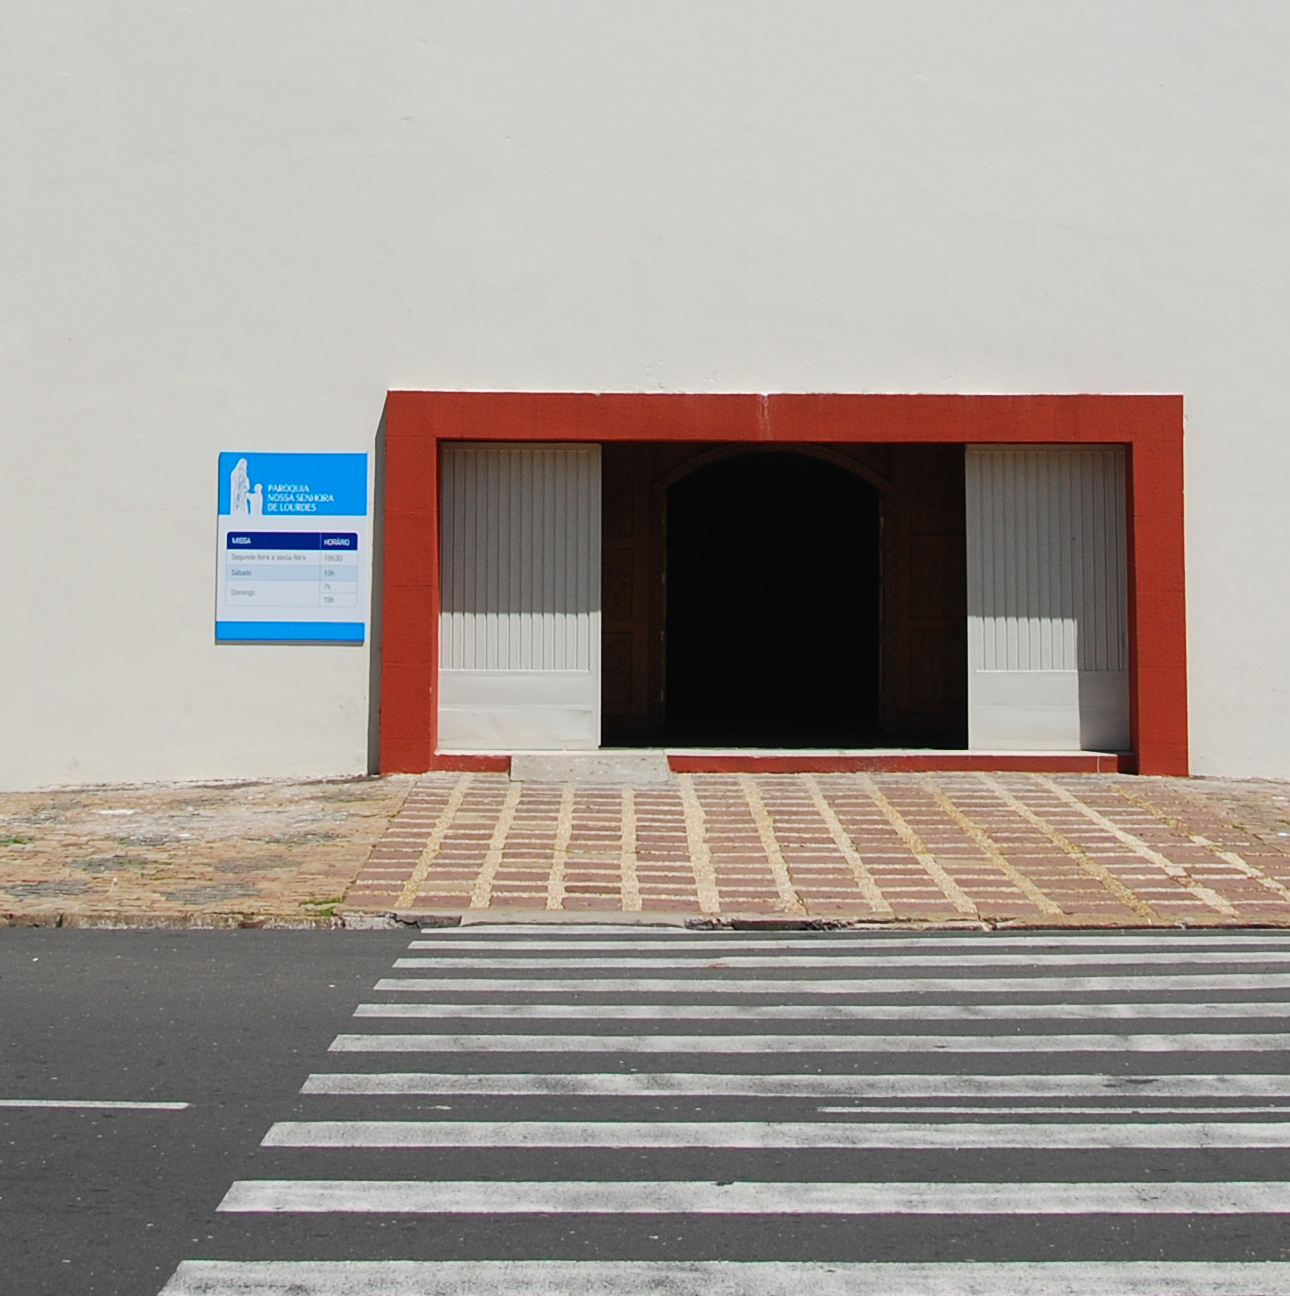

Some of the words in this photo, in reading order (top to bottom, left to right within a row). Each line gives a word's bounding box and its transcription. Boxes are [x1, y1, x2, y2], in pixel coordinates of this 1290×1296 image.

[268, 493, 295, 502] NOSSA
[296, 493, 335, 502] SENHORA
[268, 503, 278, 511] DE
[279, 503, 317, 512] LOURDES
